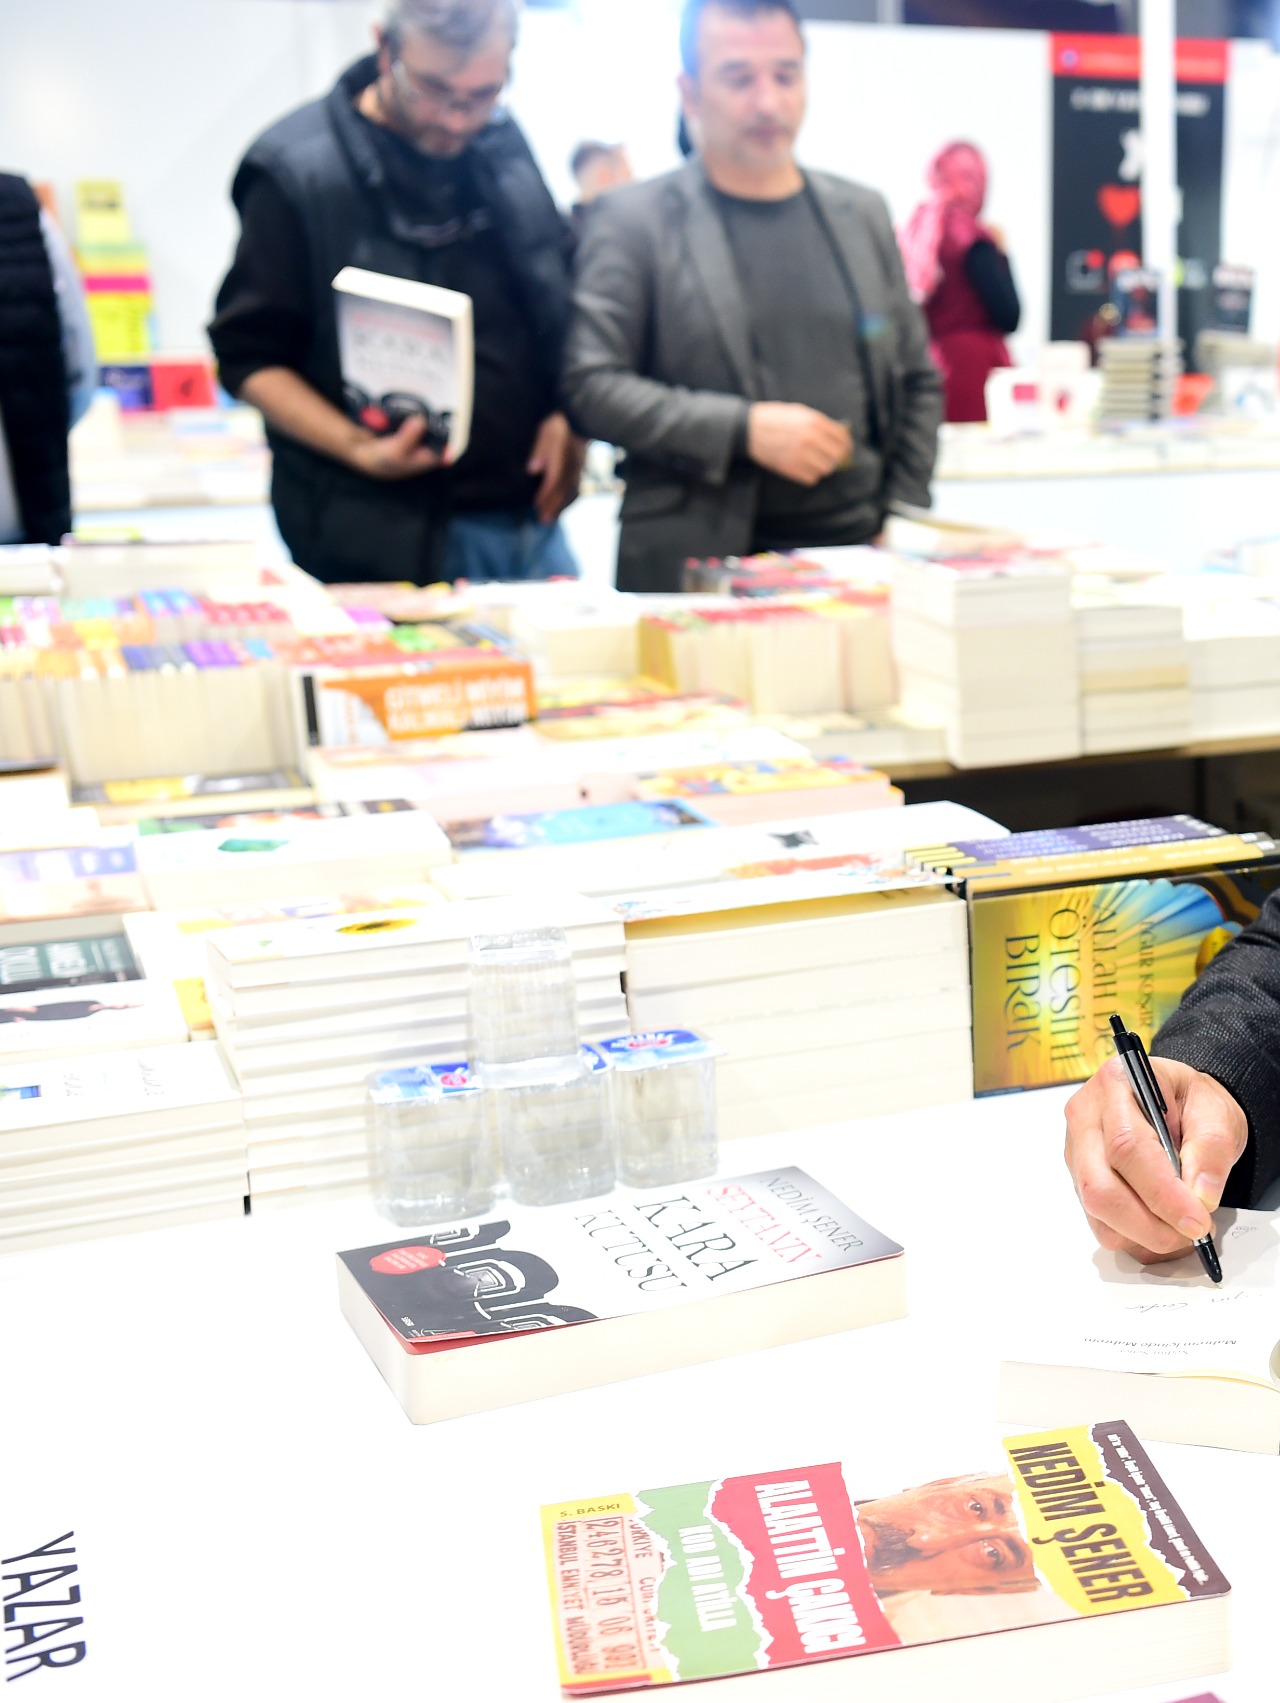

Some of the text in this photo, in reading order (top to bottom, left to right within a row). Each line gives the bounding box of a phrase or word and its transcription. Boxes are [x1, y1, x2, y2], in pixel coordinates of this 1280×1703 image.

[574, 1209, 688, 1292] KUTUSU
[633, 1195, 759, 1281] KARA
[759, 1176, 864, 1251] NEDİM ŞENER
[577, 1503, 621, 1515] BASKI
[678, 1524, 717, 1554] KOD
[1008, 1442, 1154, 1603] NEDİM ŞENER
[1, 1530, 86, 1683] YAZAR
[685, 1555, 724, 1582] ADI
[754, 1480, 867, 1654] ALAATTİN ÇAKICI
